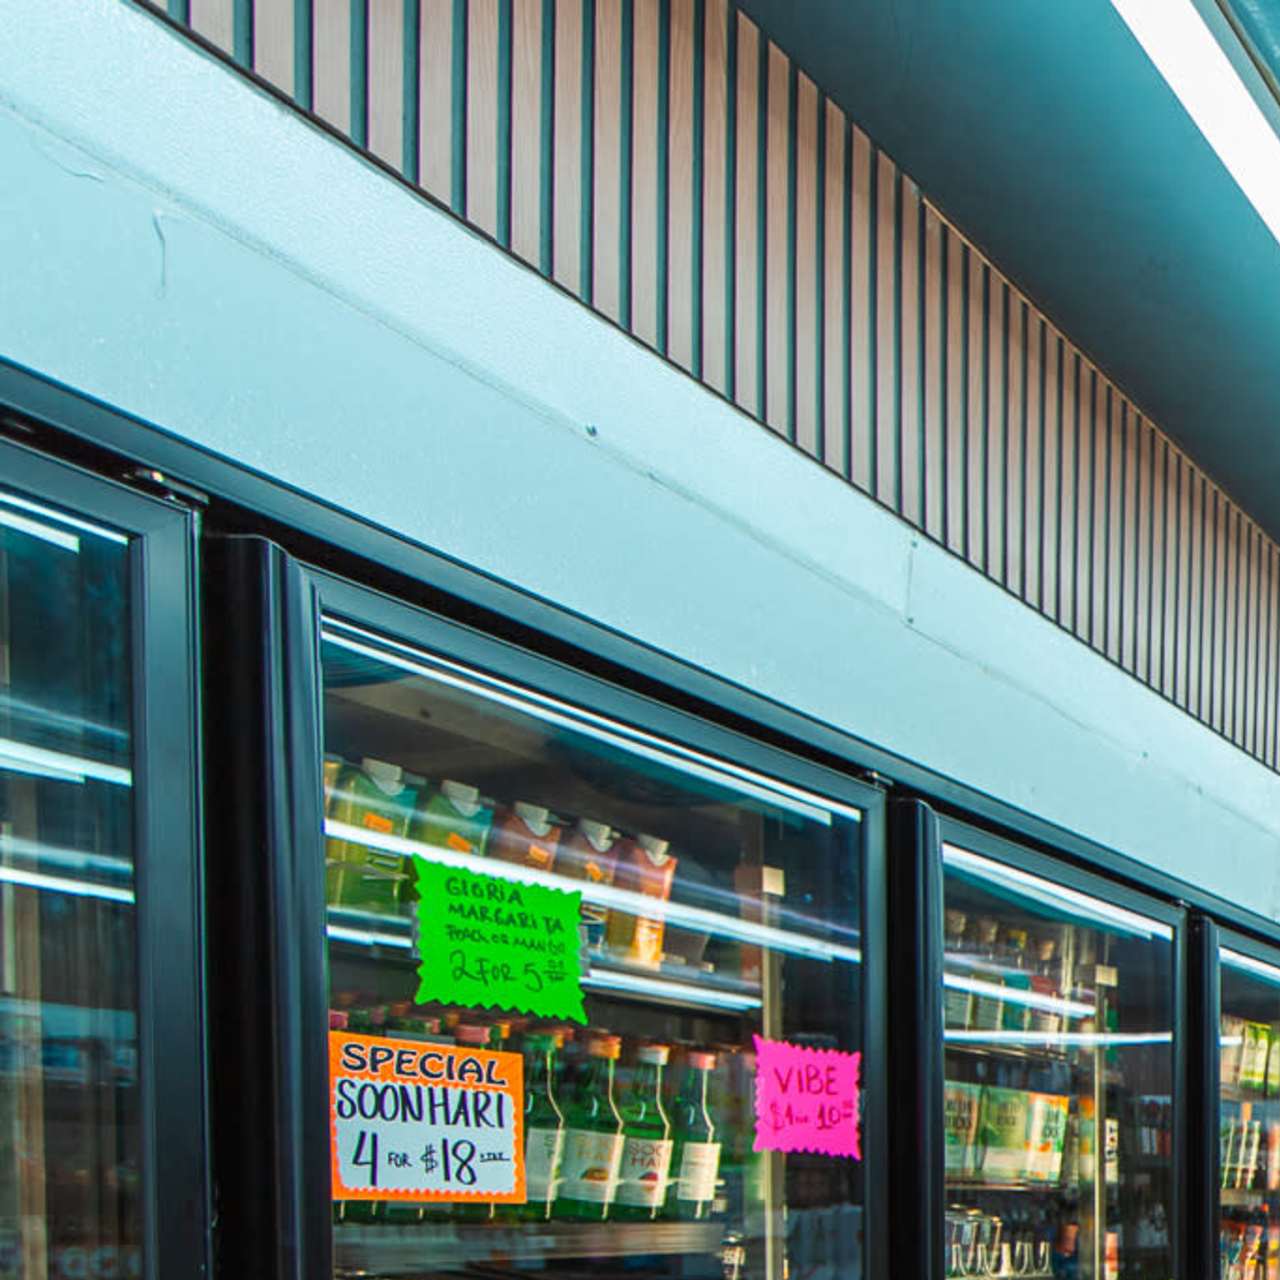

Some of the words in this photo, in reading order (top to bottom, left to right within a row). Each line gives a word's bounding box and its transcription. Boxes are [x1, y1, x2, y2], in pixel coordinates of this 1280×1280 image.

[341, 1044, 507, 1086] SPECIAL
[773, 1064, 839, 1096] VIBE
[352, 1131, 378, 1187] 4
[387, 1152, 413, 1168] FOR
[420, 1138, 477, 1186] $18
